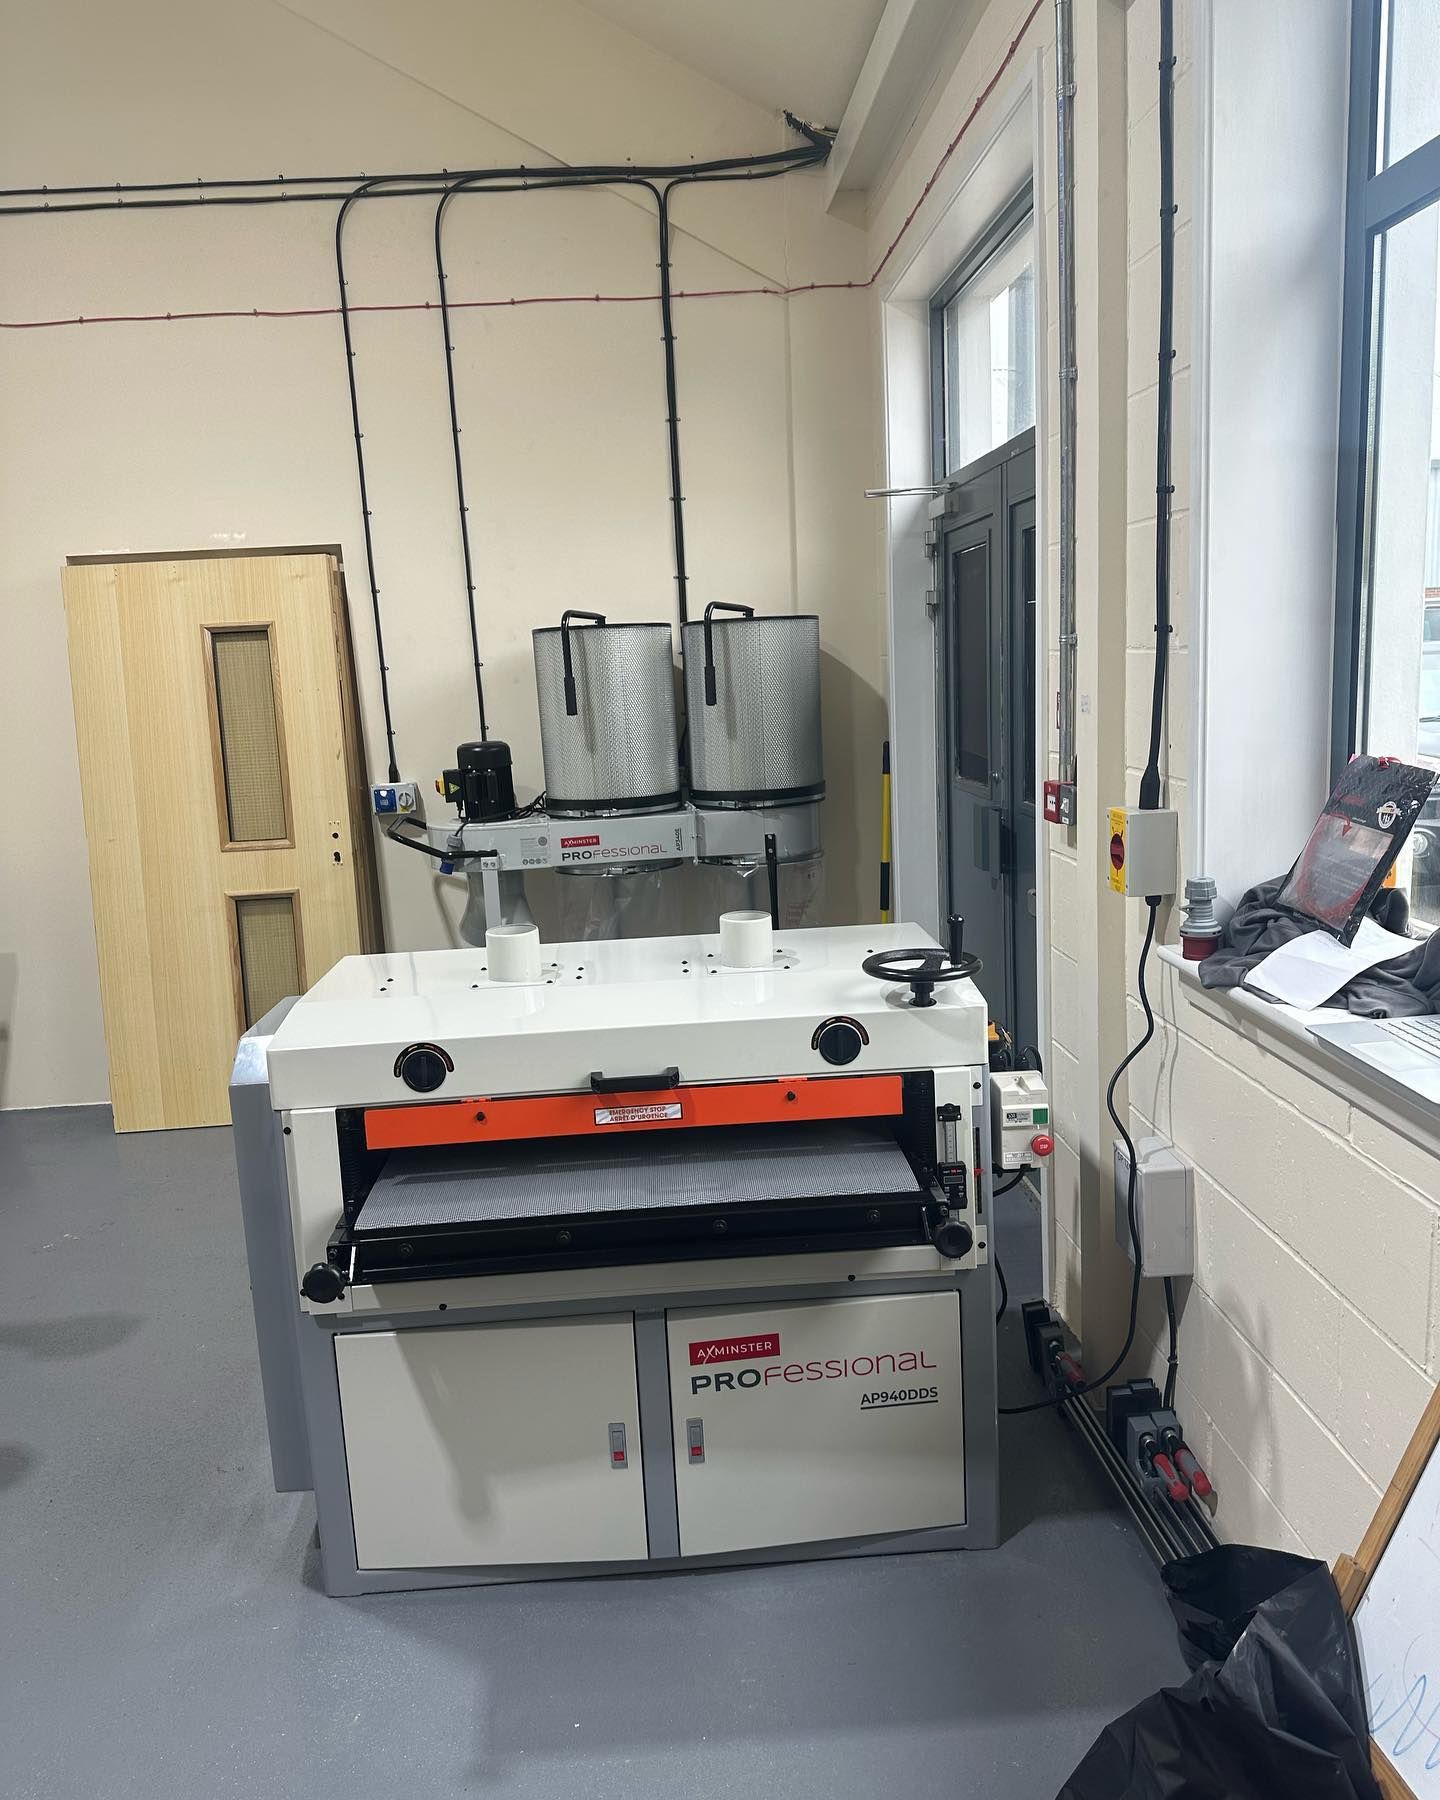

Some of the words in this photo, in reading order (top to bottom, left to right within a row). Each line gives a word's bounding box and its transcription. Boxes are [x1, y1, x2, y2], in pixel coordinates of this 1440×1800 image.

[563, 837, 597, 846] AXMINSTER
[609, 1107, 648, 1115] EMERGENCY
[631, 1112, 667, 1120] D'URGENCE
[697, 1341, 773, 1362] AXMINSTER
[860, 1386, 938, 1406] AP940DDS
